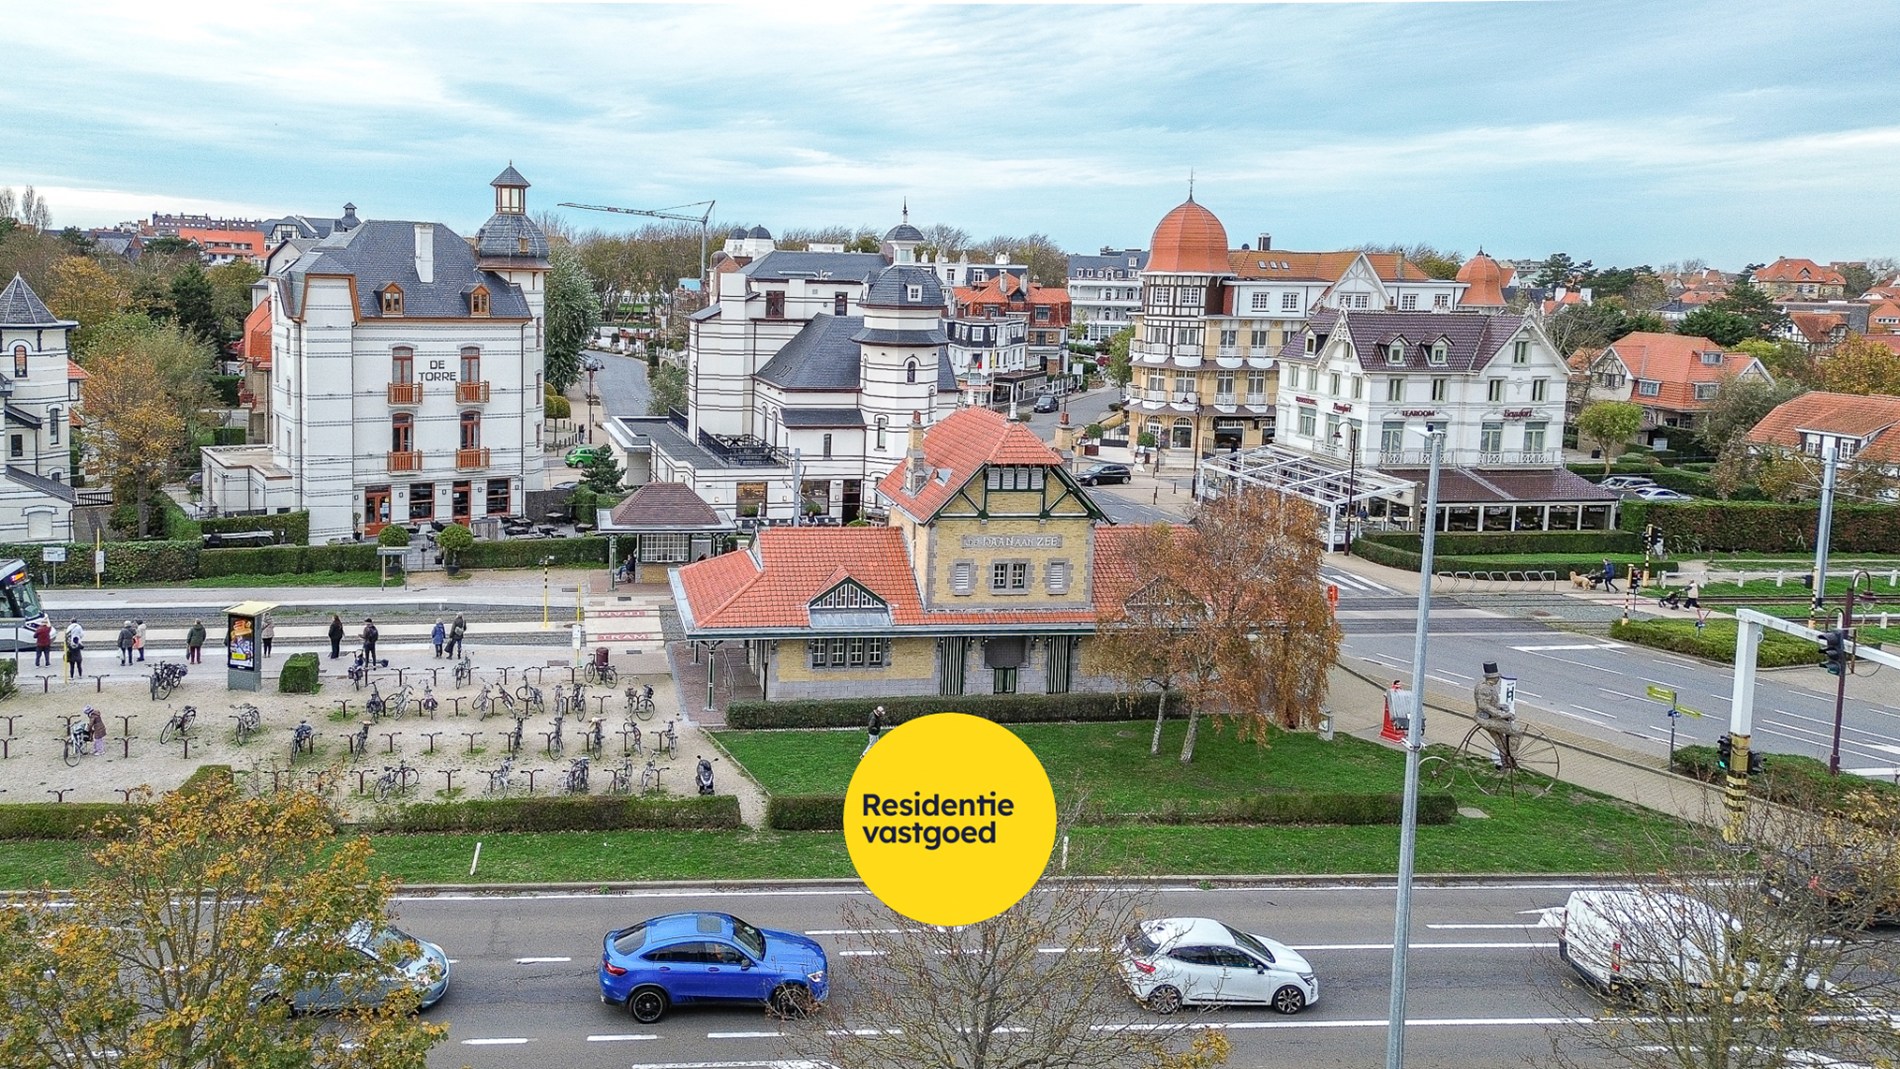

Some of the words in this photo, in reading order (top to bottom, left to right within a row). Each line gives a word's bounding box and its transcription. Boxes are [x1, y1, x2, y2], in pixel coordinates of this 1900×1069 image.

[430, 360, 445, 369] DE
[419, 372, 456, 381] TORRE
[1037, 537, 1058, 547] ZEE
